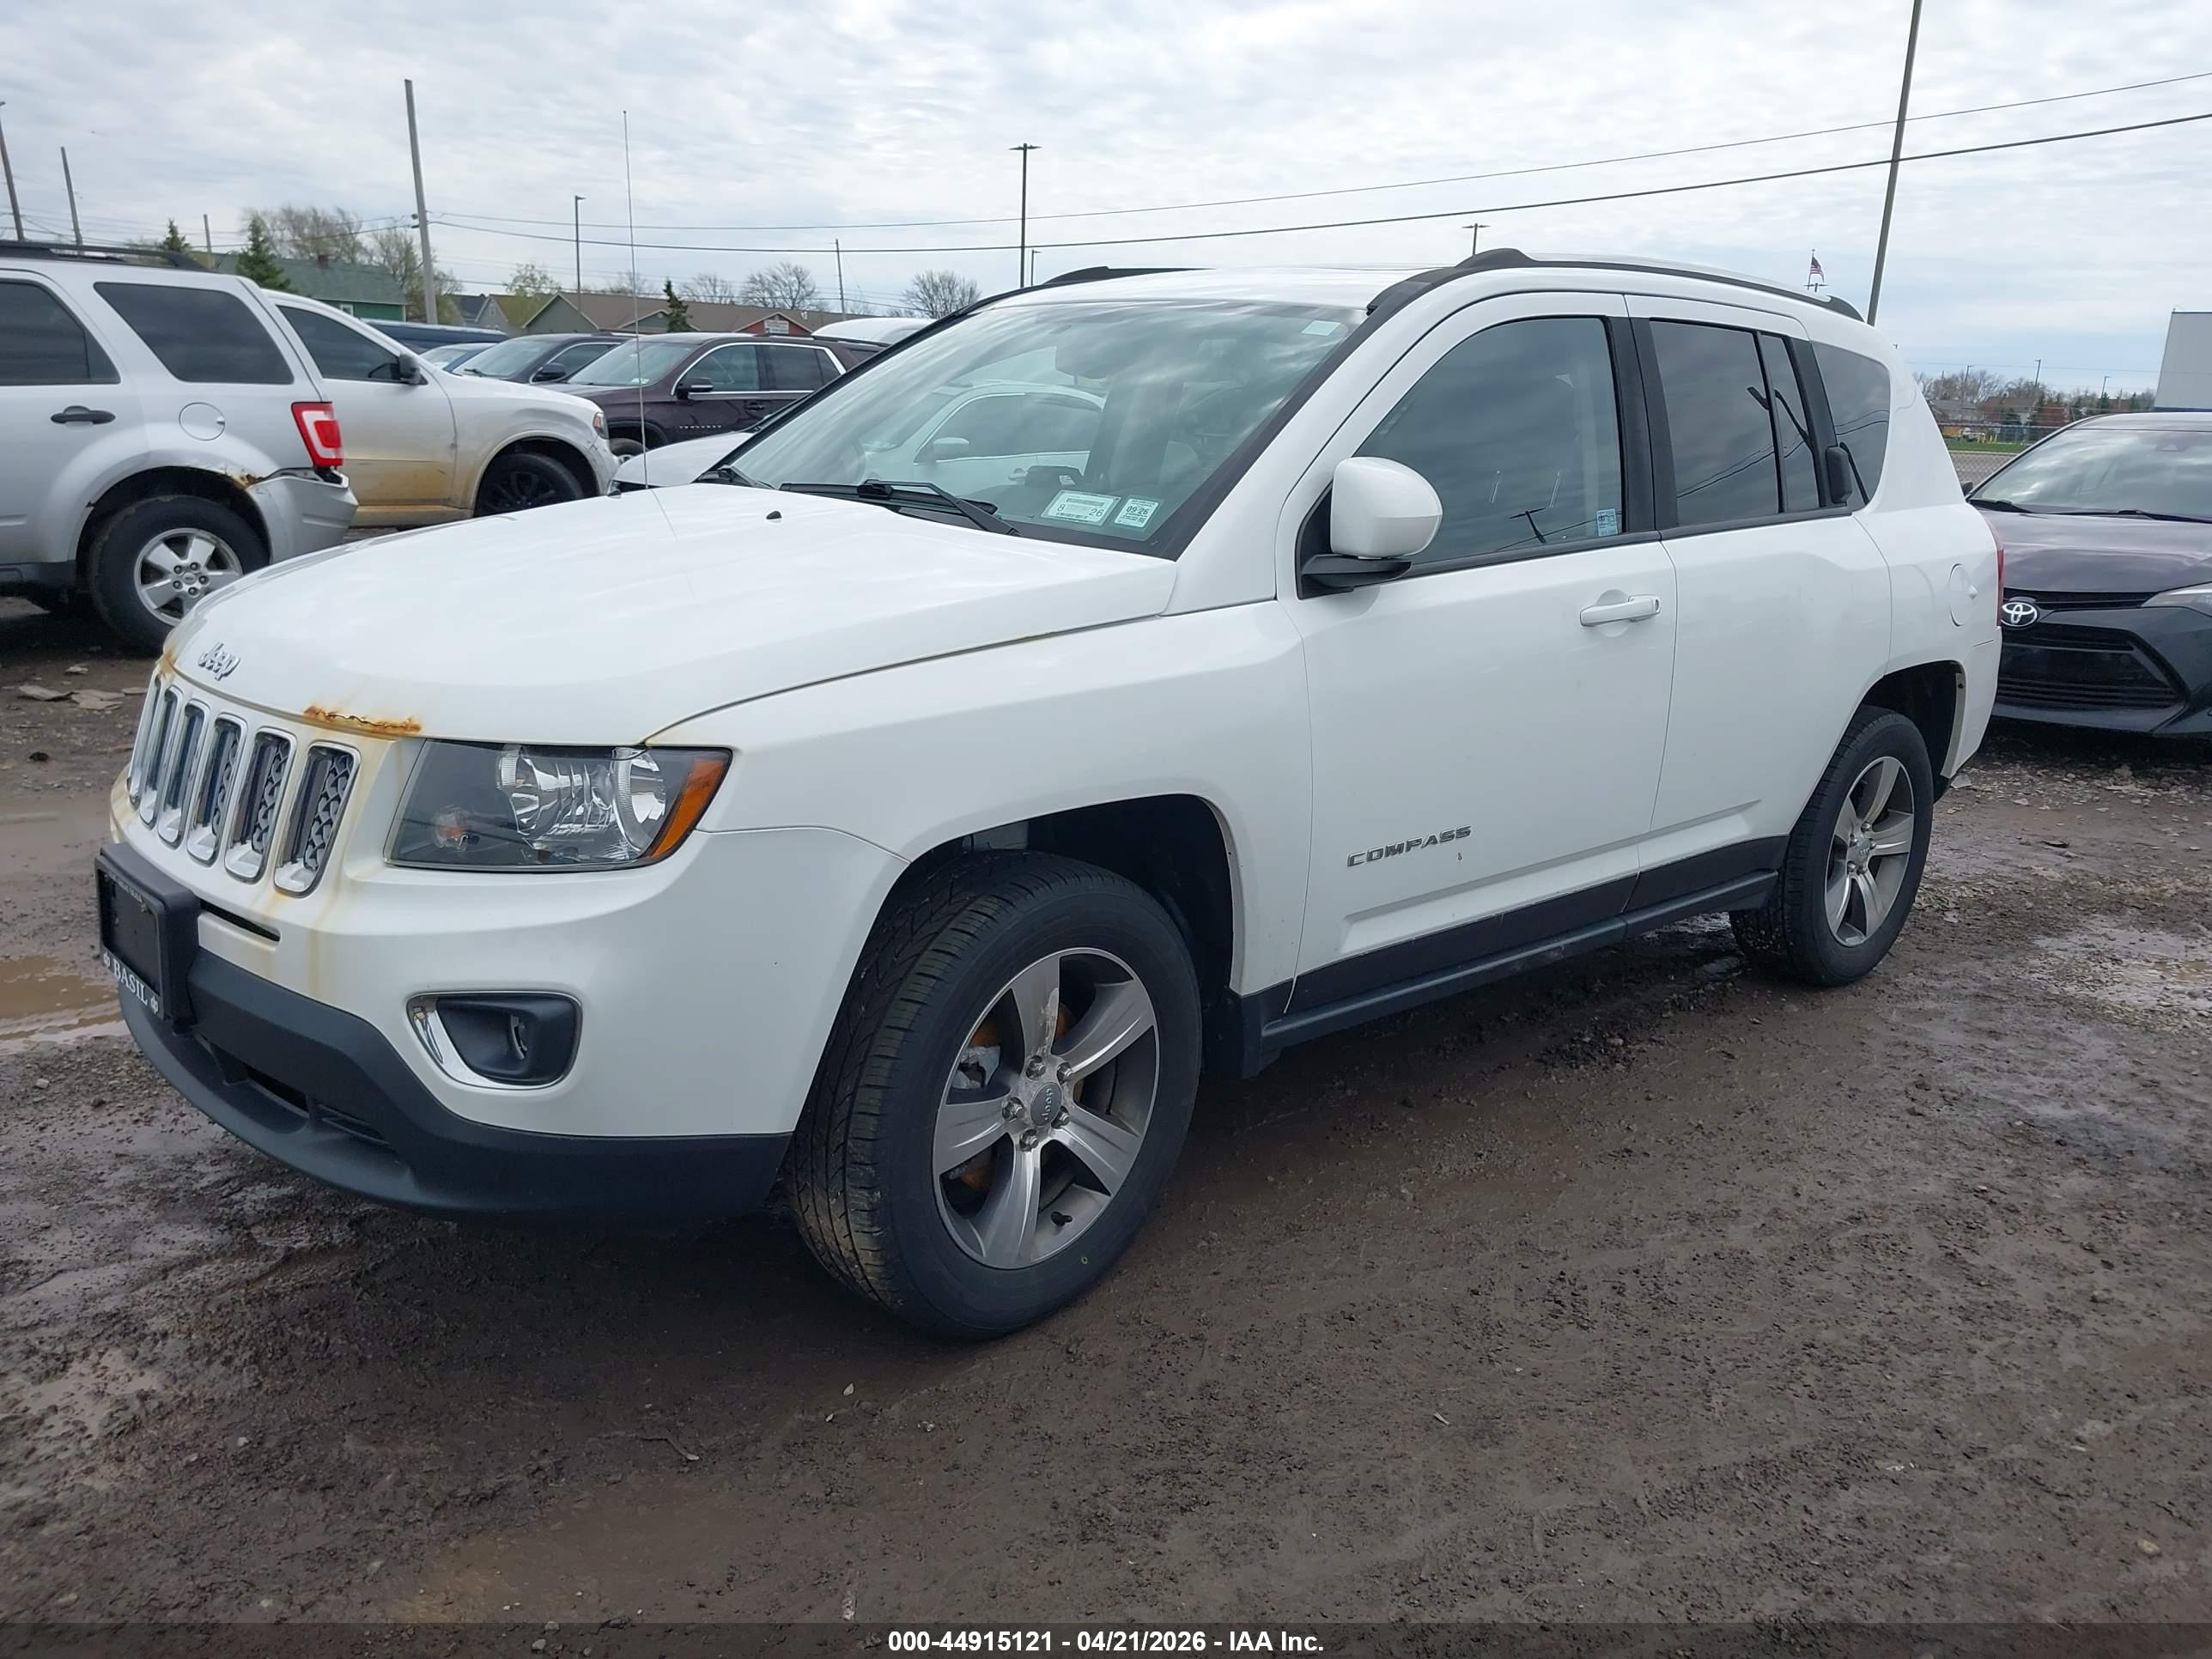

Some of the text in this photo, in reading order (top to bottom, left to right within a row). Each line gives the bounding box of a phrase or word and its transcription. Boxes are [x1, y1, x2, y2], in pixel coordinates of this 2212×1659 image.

[1089, 507, 1105, 517] 26
[198, 642, 240, 681] Jeep
[1346, 824, 1472, 867] COMPASS
[113, 958, 148, 1006] BASIL
